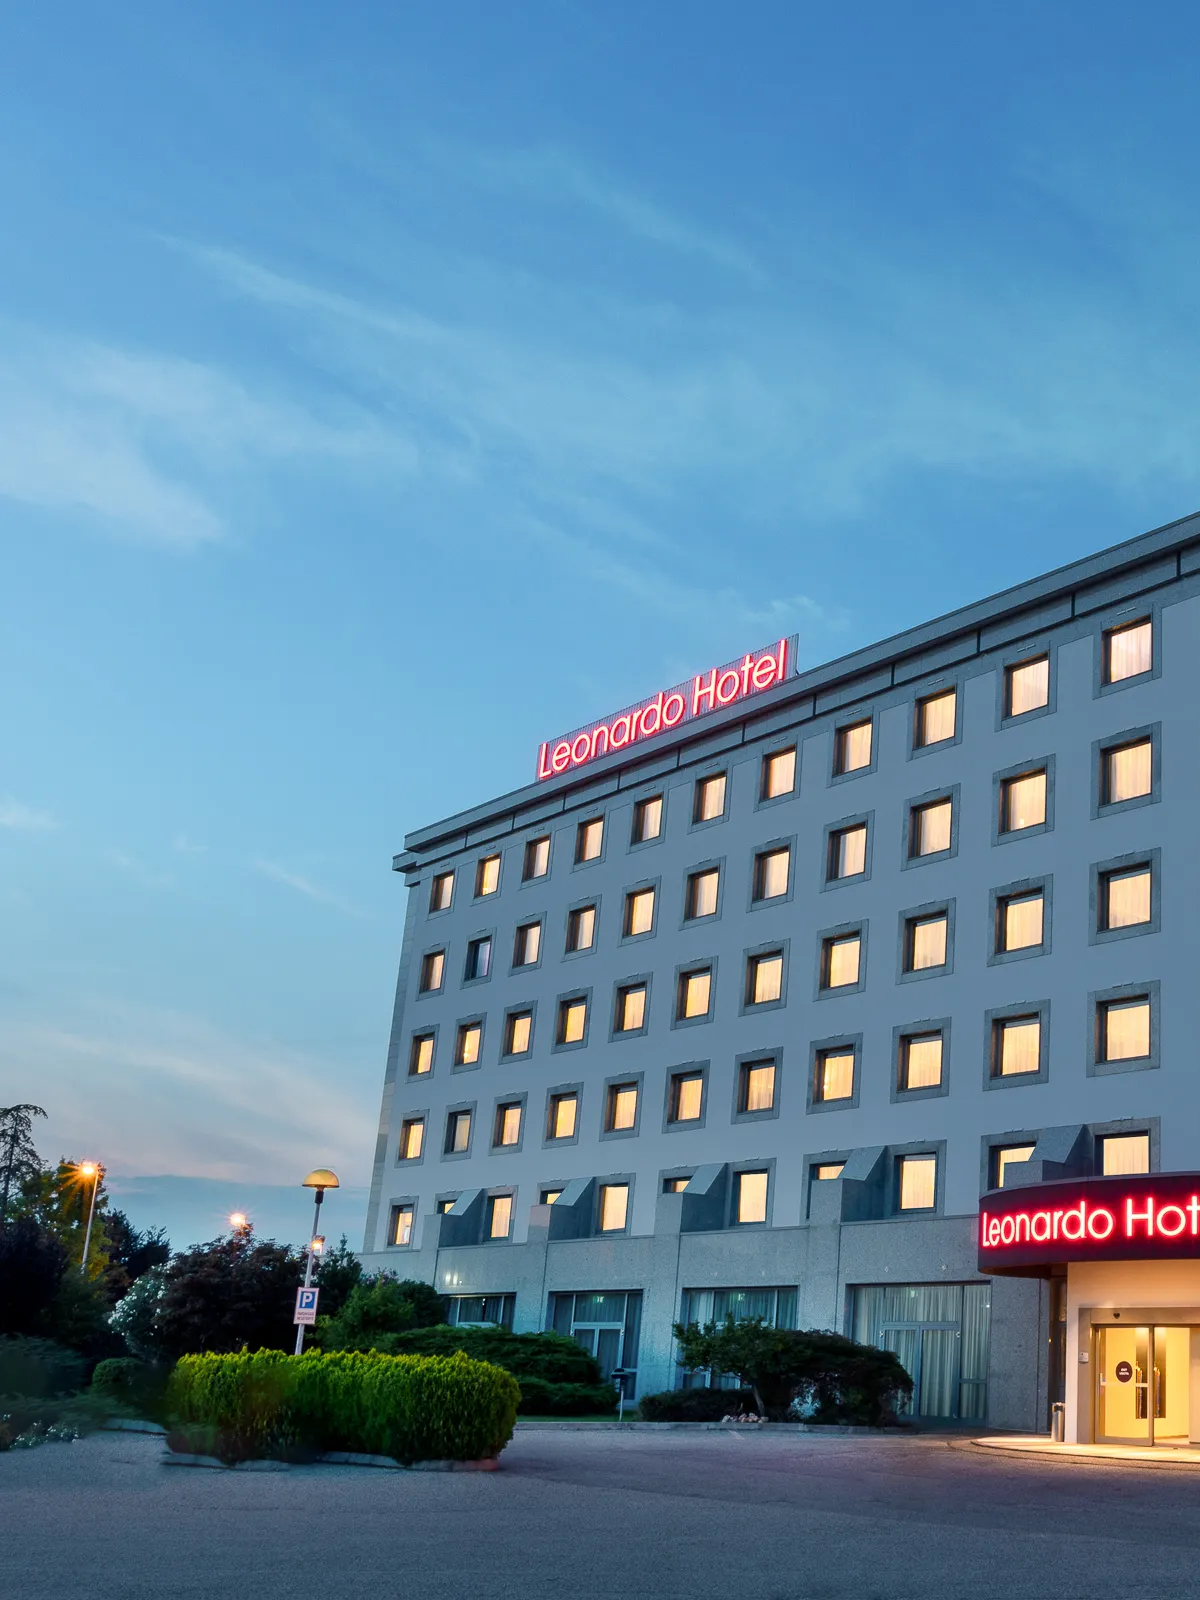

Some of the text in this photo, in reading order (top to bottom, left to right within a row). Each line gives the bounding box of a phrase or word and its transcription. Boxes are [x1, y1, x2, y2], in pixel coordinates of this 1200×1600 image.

[538, 638, 788, 779] Leonardo Hotel
[981, 1199, 1114, 1248] Leonardo
[301, 1292, 313, 1308] P
